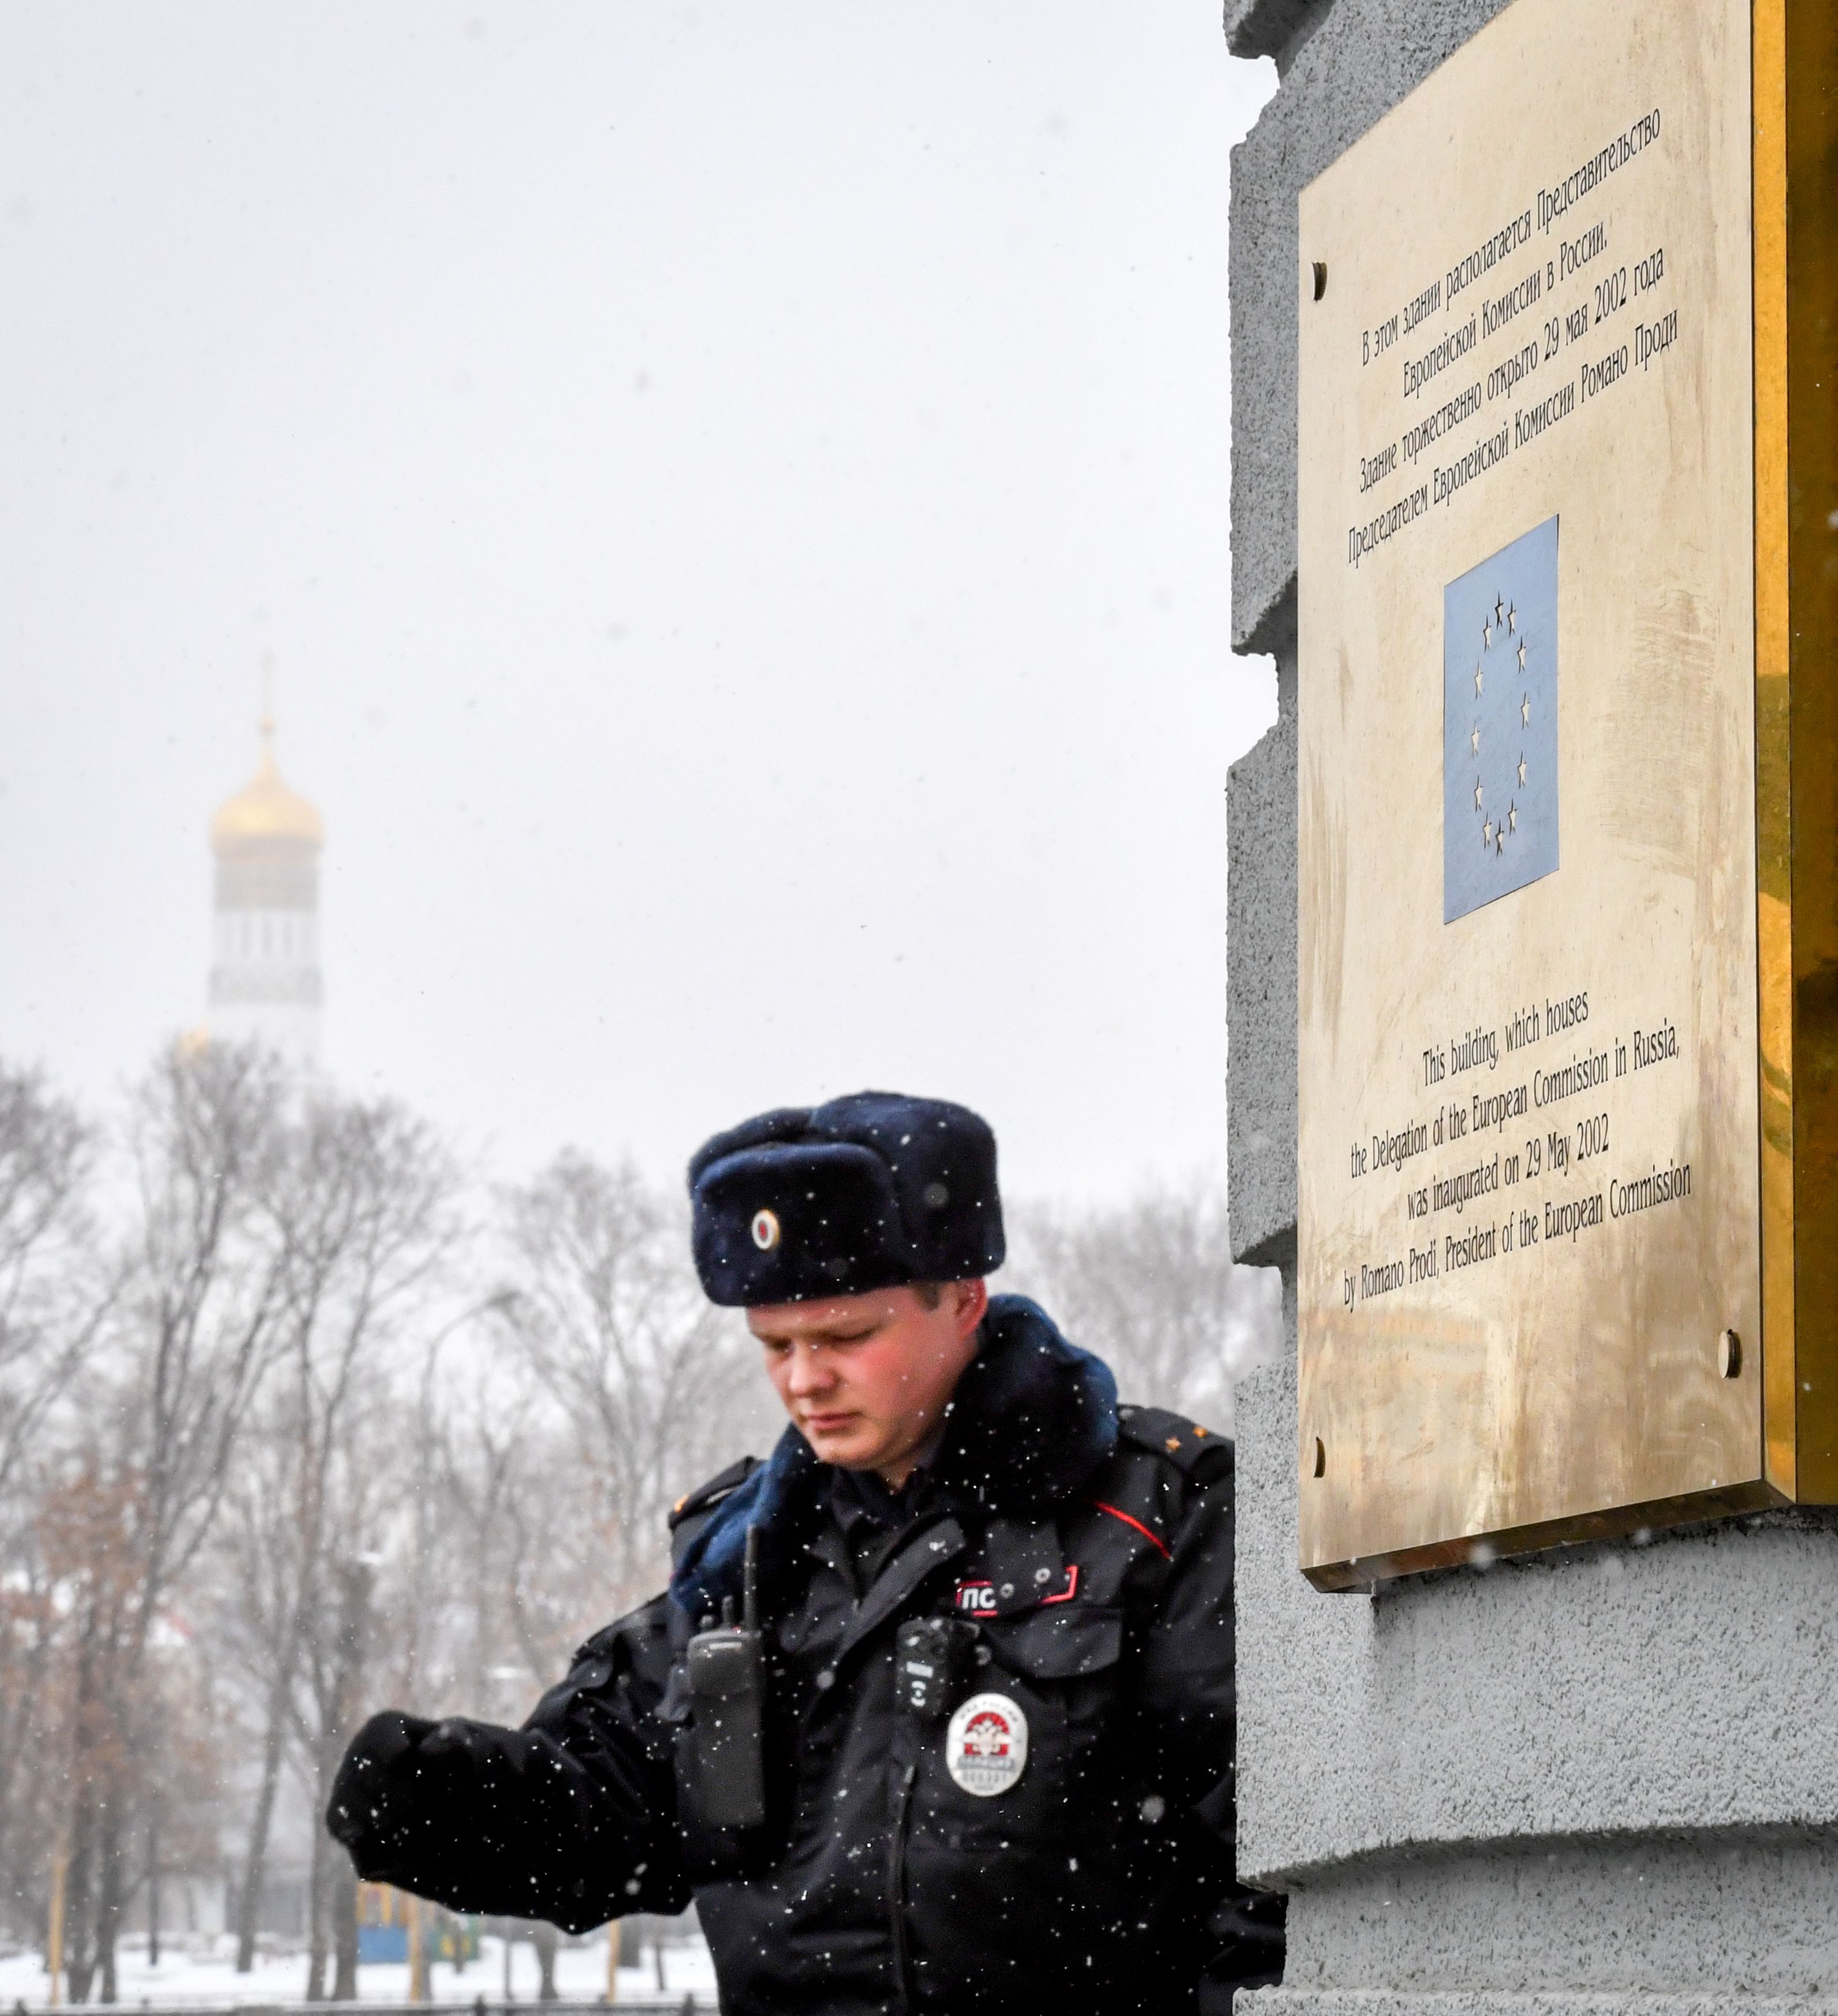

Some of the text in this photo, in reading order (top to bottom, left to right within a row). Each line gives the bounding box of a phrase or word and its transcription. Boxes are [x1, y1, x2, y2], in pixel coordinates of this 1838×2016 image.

[1362, 108, 1660, 367] В этом здании располагается Представительство
[1403, 221, 1607, 400] Европейской Комиссии в России.
[1348, 309, 1677, 569] Председателем Европейской Комиссии Романо Проди
[1359, 248, 1664, 494] Здание торжественно открыто 29 мая 2002 года
[1351, 1017, 1680, 1179] the Delegation of the European Commission in Russia,
[1422, 991, 1589, 1087] This building, which houses
[1344, 1158, 1691, 1314] by Romano Prodi, President of the European Commission
[1407, 1112, 1609, 1220] was inaugurated on 29 May 2002
